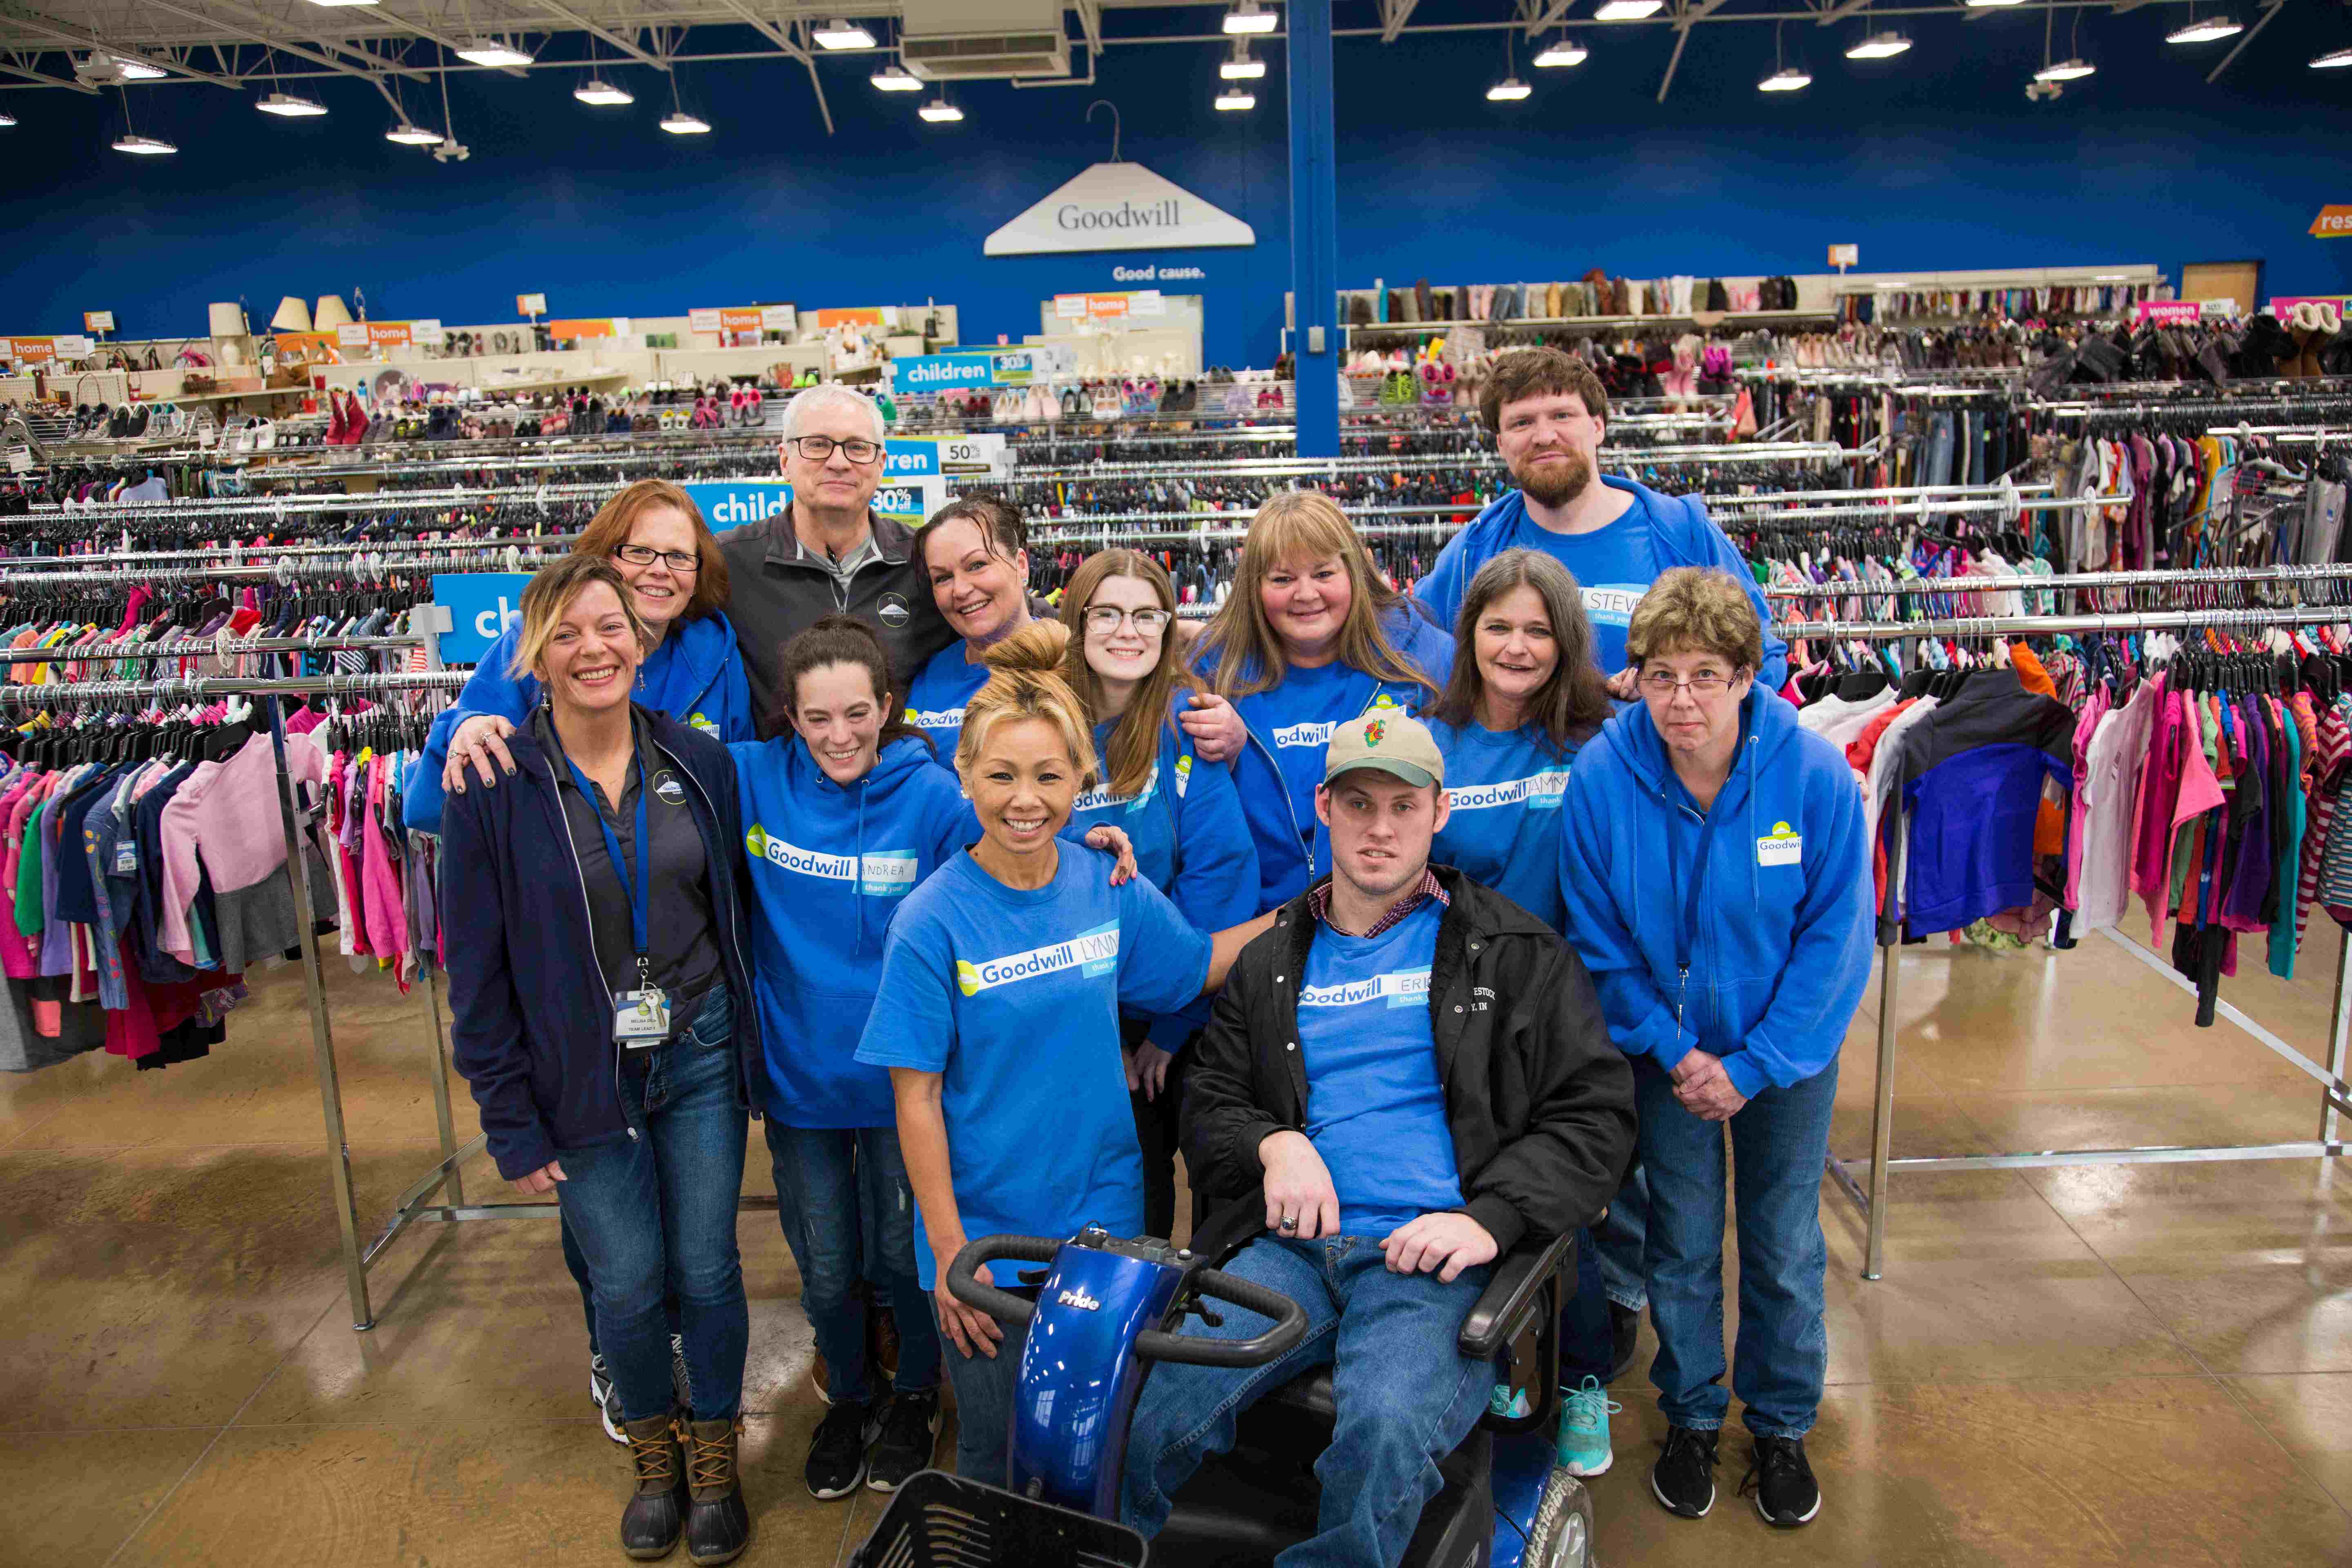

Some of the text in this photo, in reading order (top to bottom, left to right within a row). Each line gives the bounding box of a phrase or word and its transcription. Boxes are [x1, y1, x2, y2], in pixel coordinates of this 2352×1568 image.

[1058, 199, 1179, 229] Goodwill
[1113, 265, 1205, 281] Good cause.
[1089, 298, 1126, 310] home
[2149, 306, 2195, 316] women
[723, 313, 759, 325] home
[371, 326, 408, 339] home
[14, 341, 53, 354] home
[908, 362, 985, 382] children
[885, 454, 928, 470] ren
[713, 491, 786, 522] child
[1594, 612, 1614, 620] thank
[1277, 725, 1328, 745] odwill
[1450, 781, 1526, 807] Goodwill
[768, 842, 851, 877] Goodwill
[865, 882, 887, 892] thank
[982, 945, 1074, 983] Goodwill
[1091, 960, 1109, 971] thank
[1298, 977, 1381, 1003] oodwill
[1473, 987, 1495, 1000] ESTOCK
[1399, 994, 1423, 1003] thank
[1479, 1002, 1487, 1010] IN
[1058, 1287, 1100, 1312] Pride
